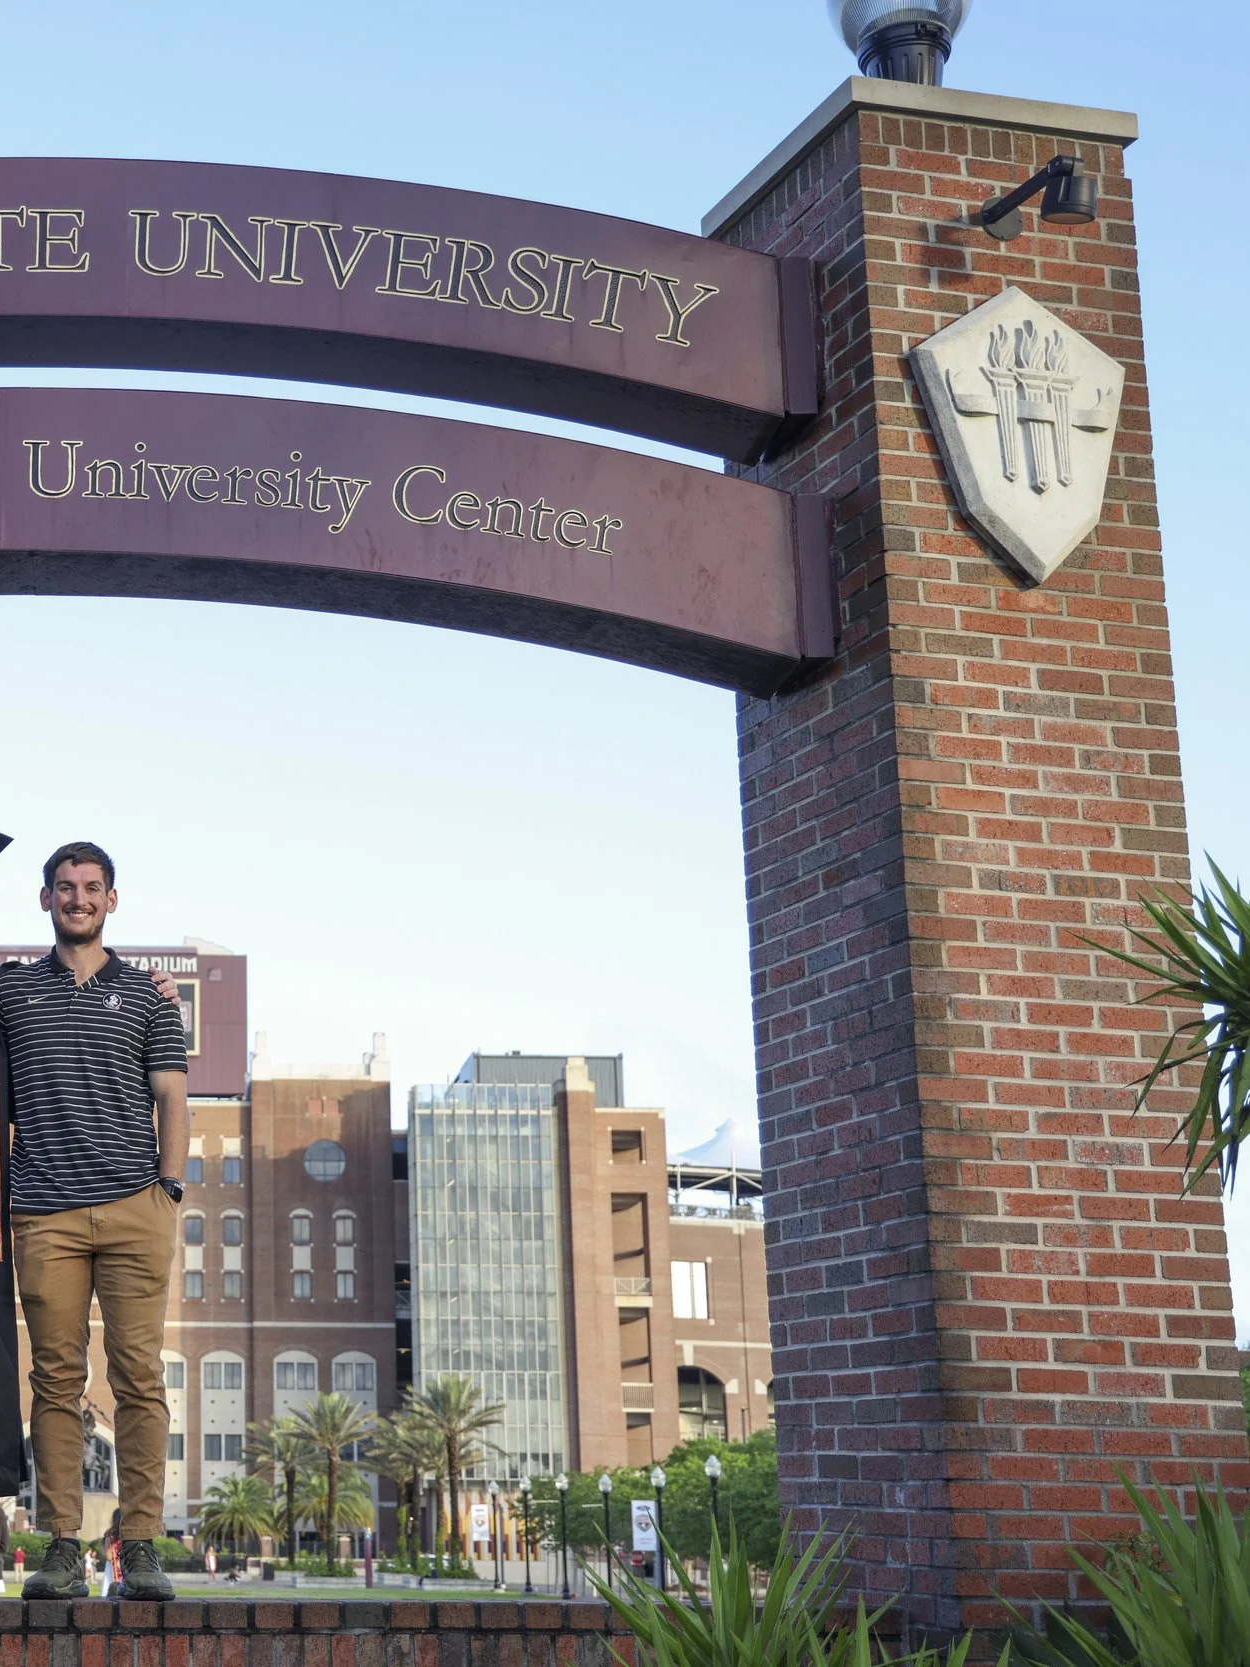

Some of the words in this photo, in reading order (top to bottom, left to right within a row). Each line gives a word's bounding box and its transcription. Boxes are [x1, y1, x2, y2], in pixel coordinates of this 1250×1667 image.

[128, 210, 719, 347] UNIVERSITY
[22, 439, 370, 533] University
[392, 465, 623, 556] Center
[119, 957, 198, 972] TADIUM
